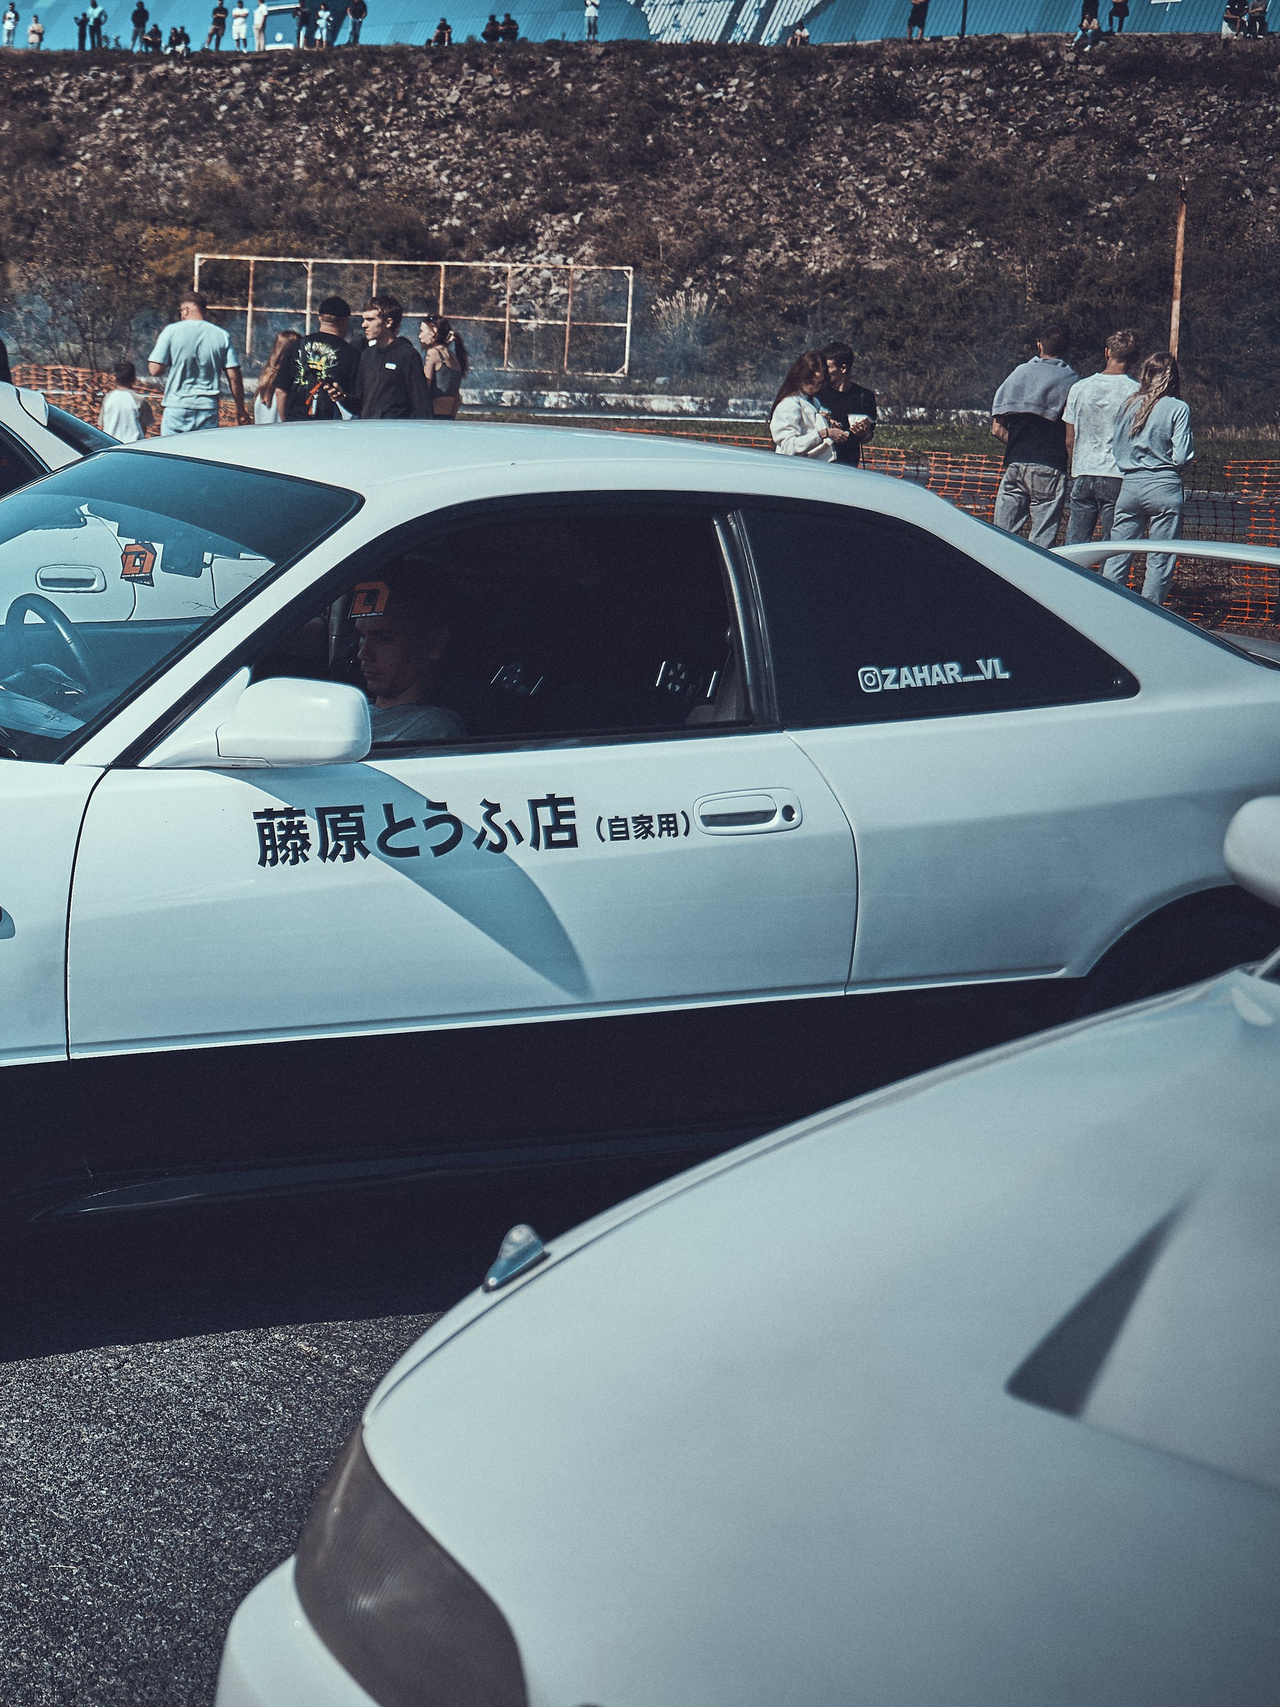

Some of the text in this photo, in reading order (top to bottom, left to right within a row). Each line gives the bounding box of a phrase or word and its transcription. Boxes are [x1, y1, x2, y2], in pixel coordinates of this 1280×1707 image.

[252, 793, 579, 868] 藤原とうふ店
